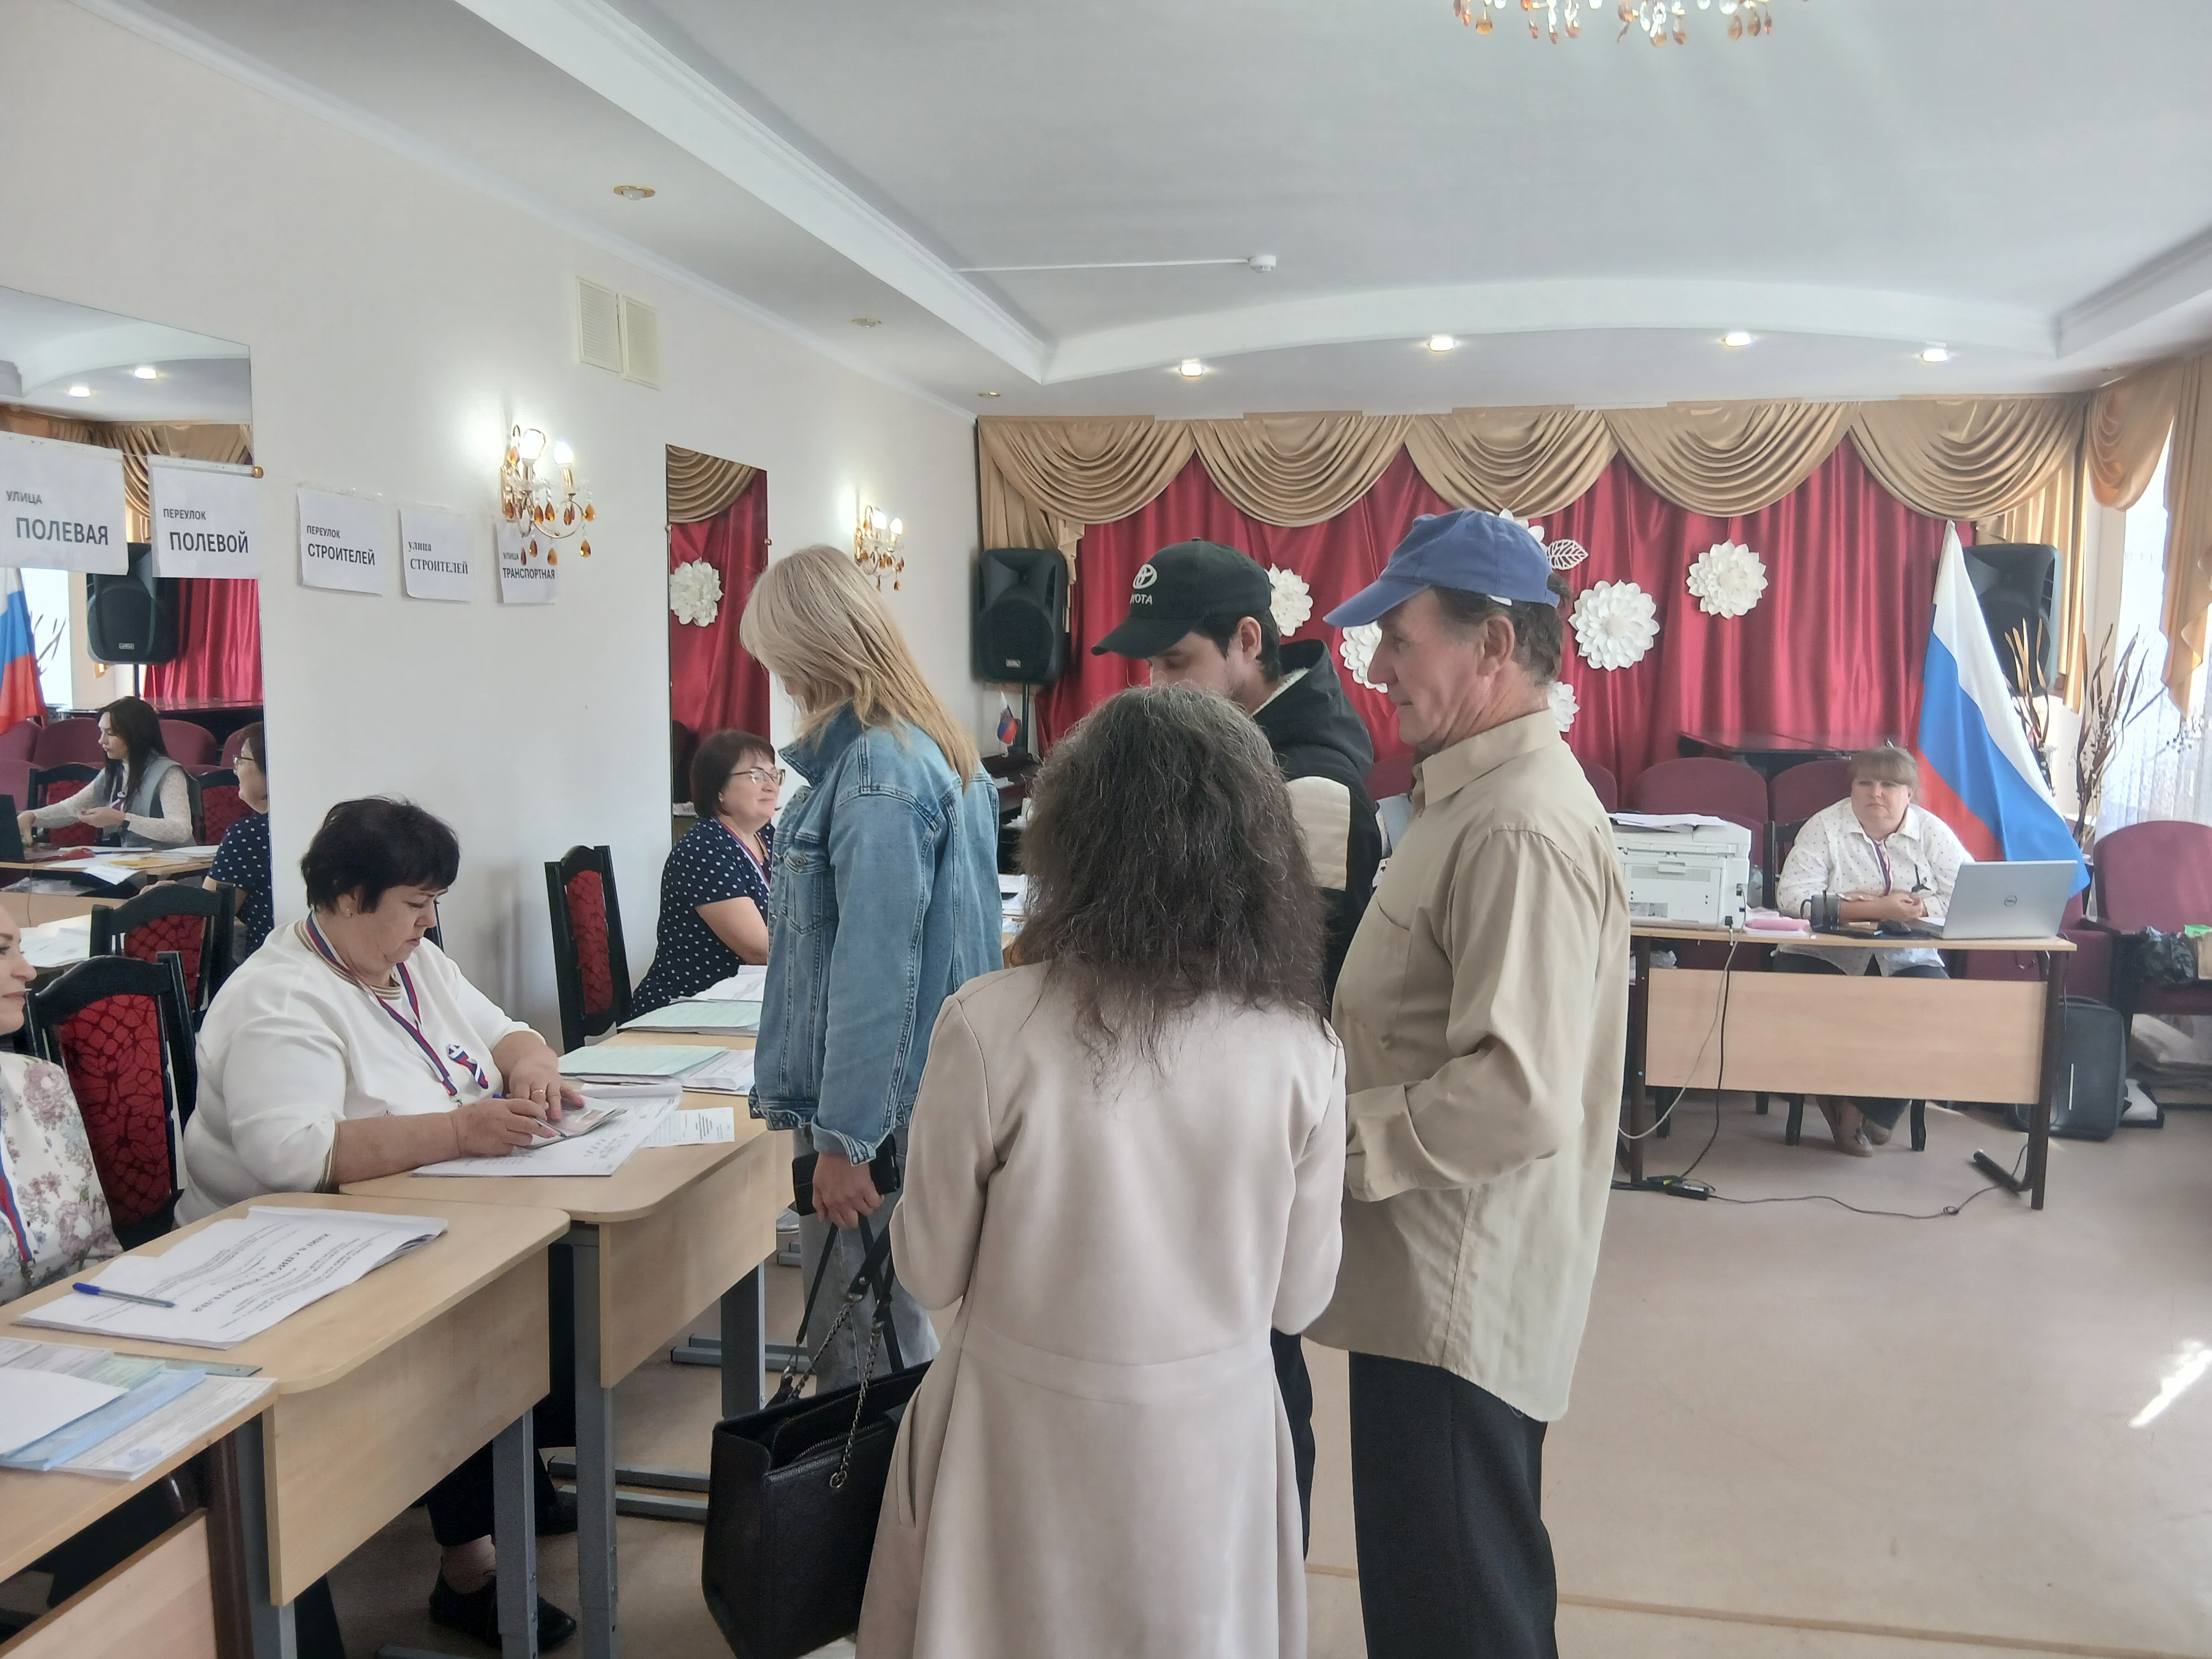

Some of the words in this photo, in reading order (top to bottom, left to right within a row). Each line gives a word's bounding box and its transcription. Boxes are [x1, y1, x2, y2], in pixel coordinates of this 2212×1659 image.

[6, 491, 42, 505] УЛИЦА
[163, 508, 206, 520] ПЕРЕУЛОК
[16, 517, 108, 545] ПОЛЕВАЯ
[306, 525, 340, 539] ПЕРЕУЛОК
[170, 530, 248, 553] ПОЛЕВОЙ
[408, 541, 432, 552] улица
[307, 543, 375, 565] СТРОИТЕЛЕЙ
[503, 552, 519, 561] УЛИЦА
[410, 558, 468, 574] СТРОИТЕЛЕЙ
[502, 567, 555, 580] ТРАНСПОРТНАЯ
